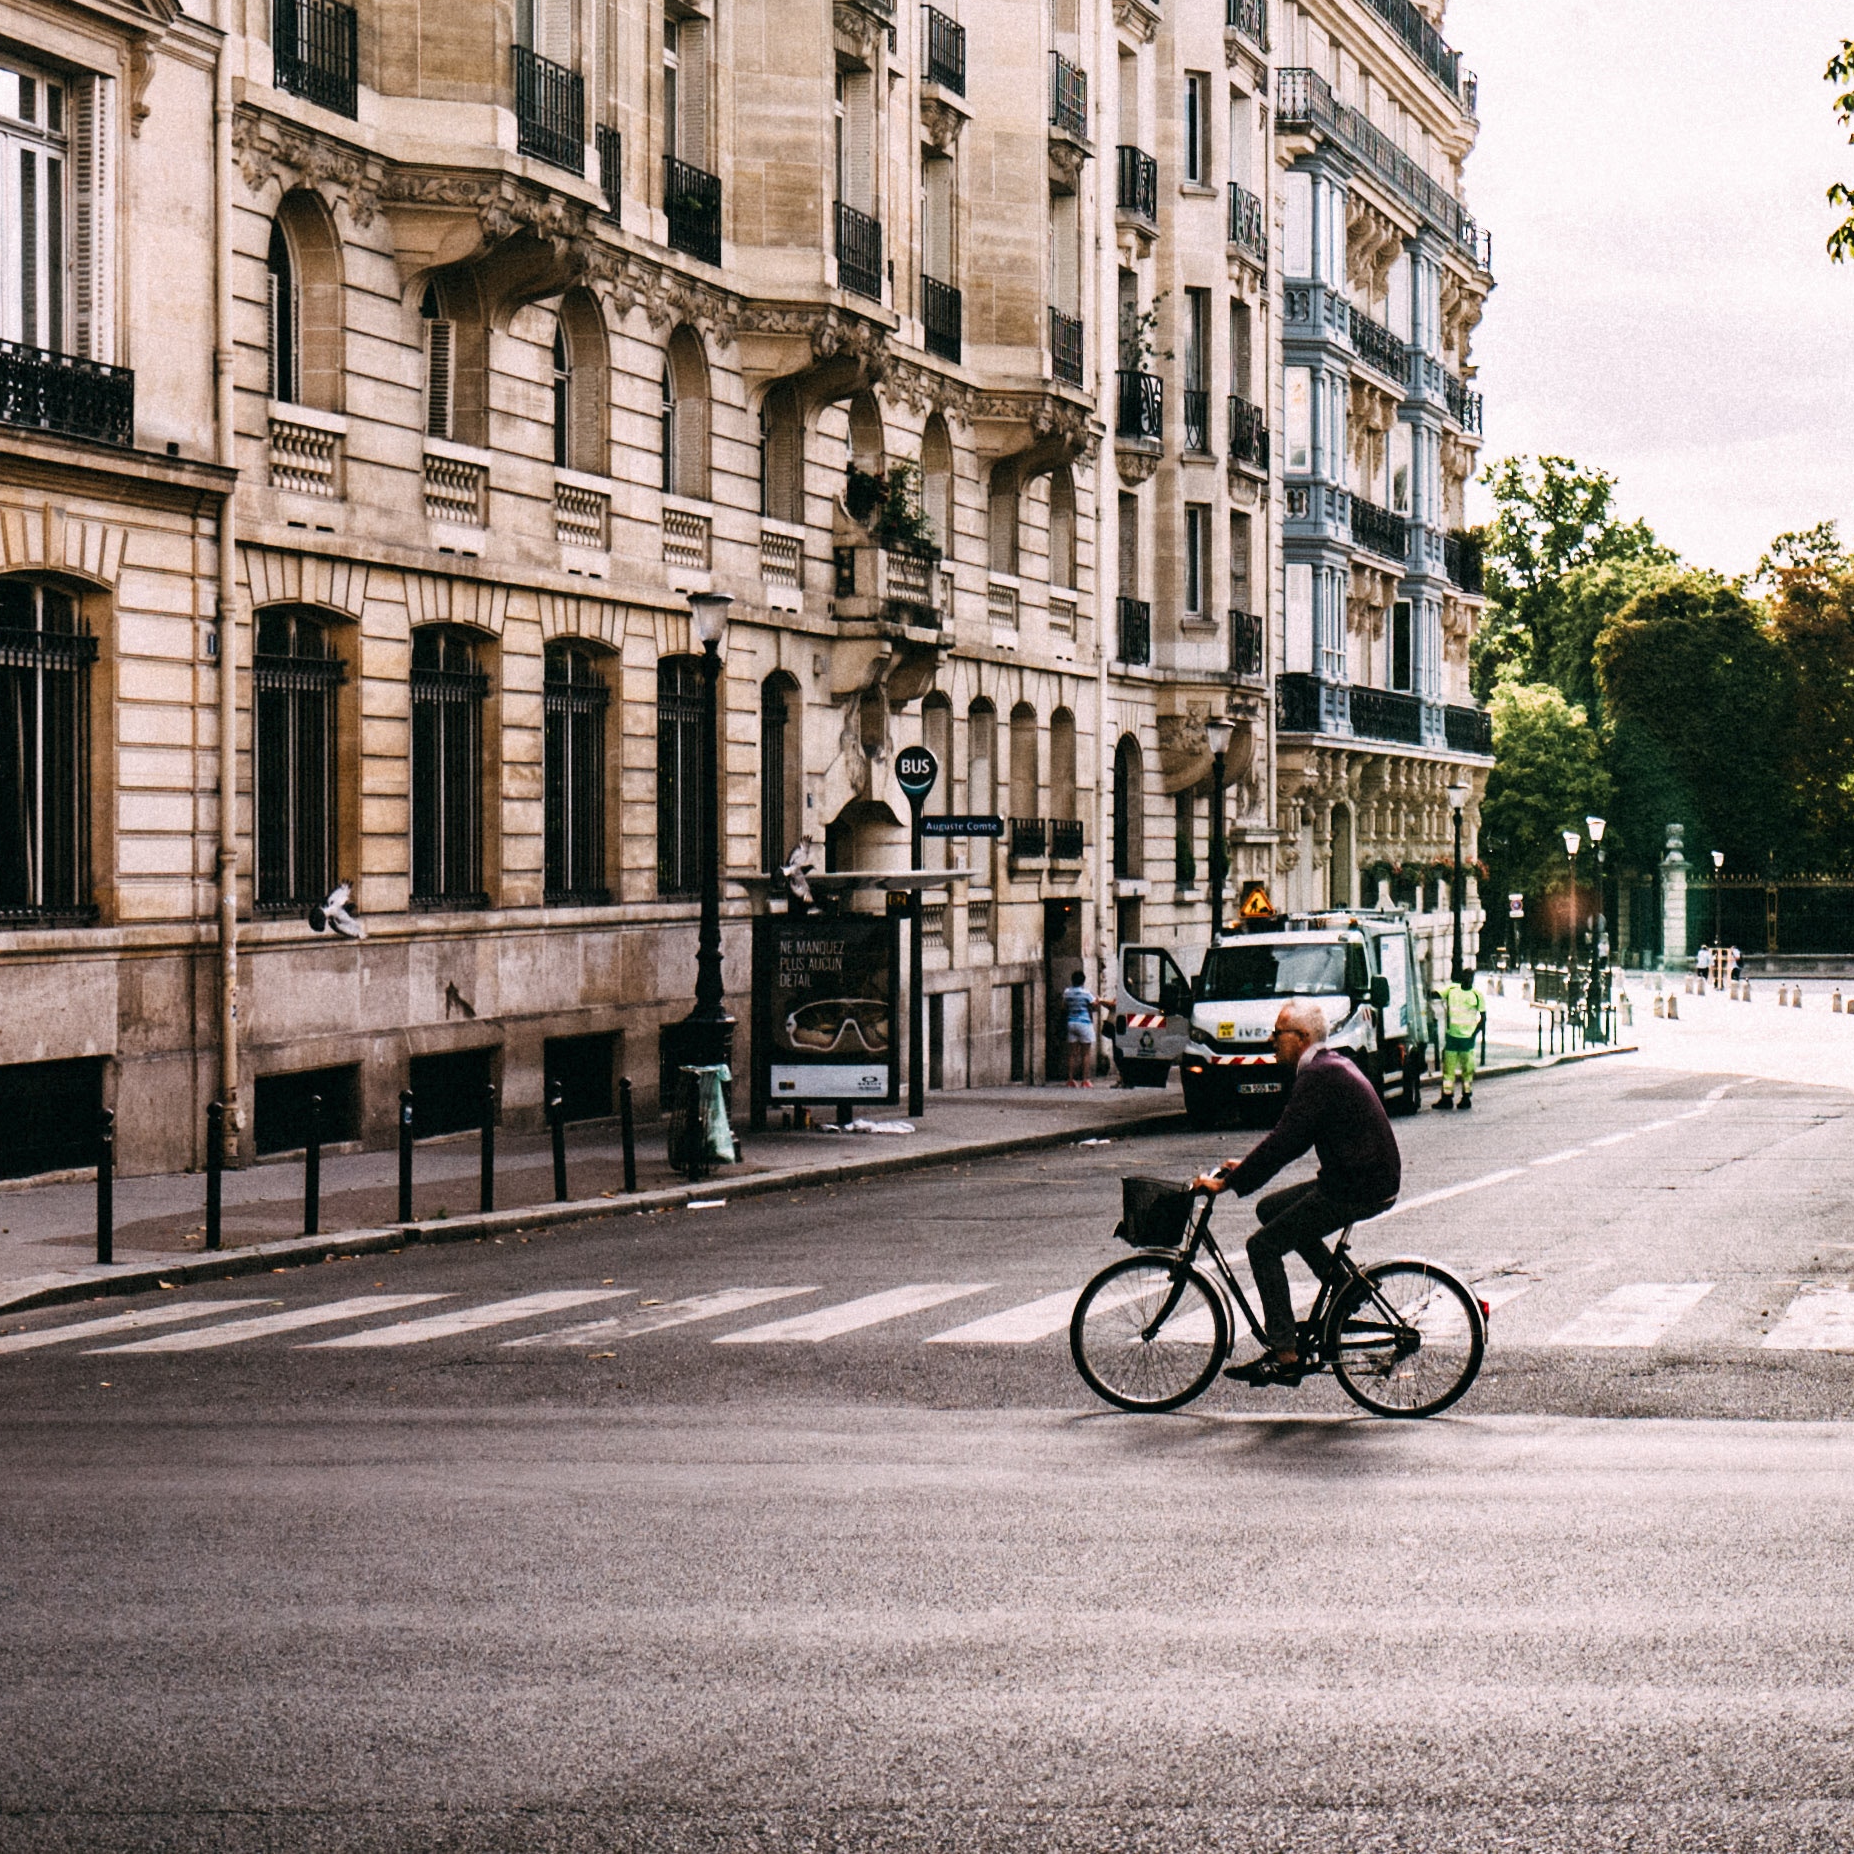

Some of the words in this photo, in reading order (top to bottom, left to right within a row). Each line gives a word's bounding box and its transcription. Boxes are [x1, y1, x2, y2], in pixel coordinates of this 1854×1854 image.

[901, 758, 930, 774] BUS
[926, 822, 964, 833] Auguste
[966, 822, 997, 831] Comte
[780, 941, 793, 955] NE
[796, 941, 845, 955] MANQUEZ
[779, 957, 805, 971] PLUS
[808, 957, 843, 971] AUCUN
